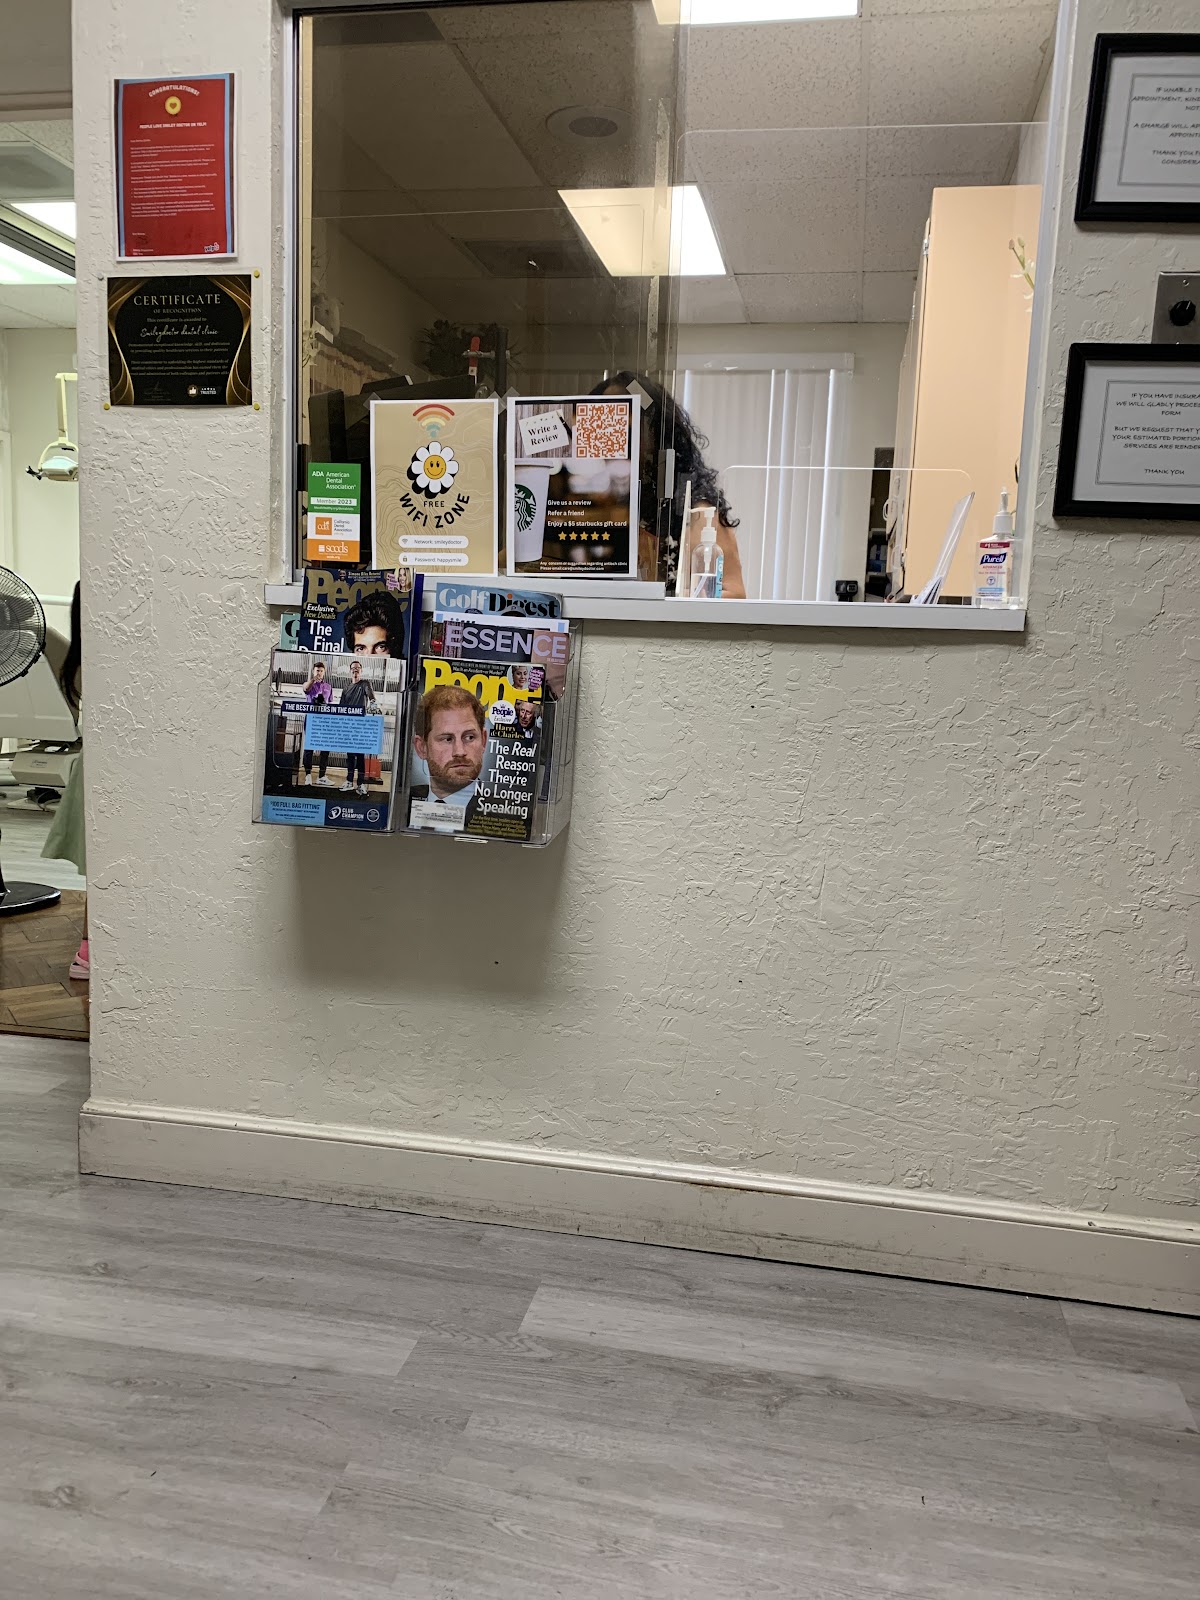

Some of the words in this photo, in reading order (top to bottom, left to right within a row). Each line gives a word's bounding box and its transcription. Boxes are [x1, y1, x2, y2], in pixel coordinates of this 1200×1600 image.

[148, 84, 201, 98] CONGRATULATIONS!
[133, 293, 221, 306] CERTIFICATE
[528, 426, 551, 436] Write
[530, 433, 559, 446] Review
[400, 493, 429, 527] WIFI
[434, 493, 470, 529] ZONE
[303, 569, 410, 613] Peoe
[439, 588, 490, 609] Golf
[306, 604, 334, 612] Exclusive
[308, 619, 332, 636] The
[314, 636, 344, 652] Final
[445, 624, 566, 658] ESSENCE
[423, 659, 542, 717] Peope
[285, 703, 295, 711] THE
[492, 707, 513, 717] People
[498, 731, 525, 739] Charles
[489, 739, 509, 754] The
[511, 742, 537, 757] Real
[496, 755, 536, 772] Reason
[488, 769, 528, 789] They're
[474, 783, 491, 797] No
[493, 784, 533, 804] Longer
[477, 798, 528, 819] Speaking
